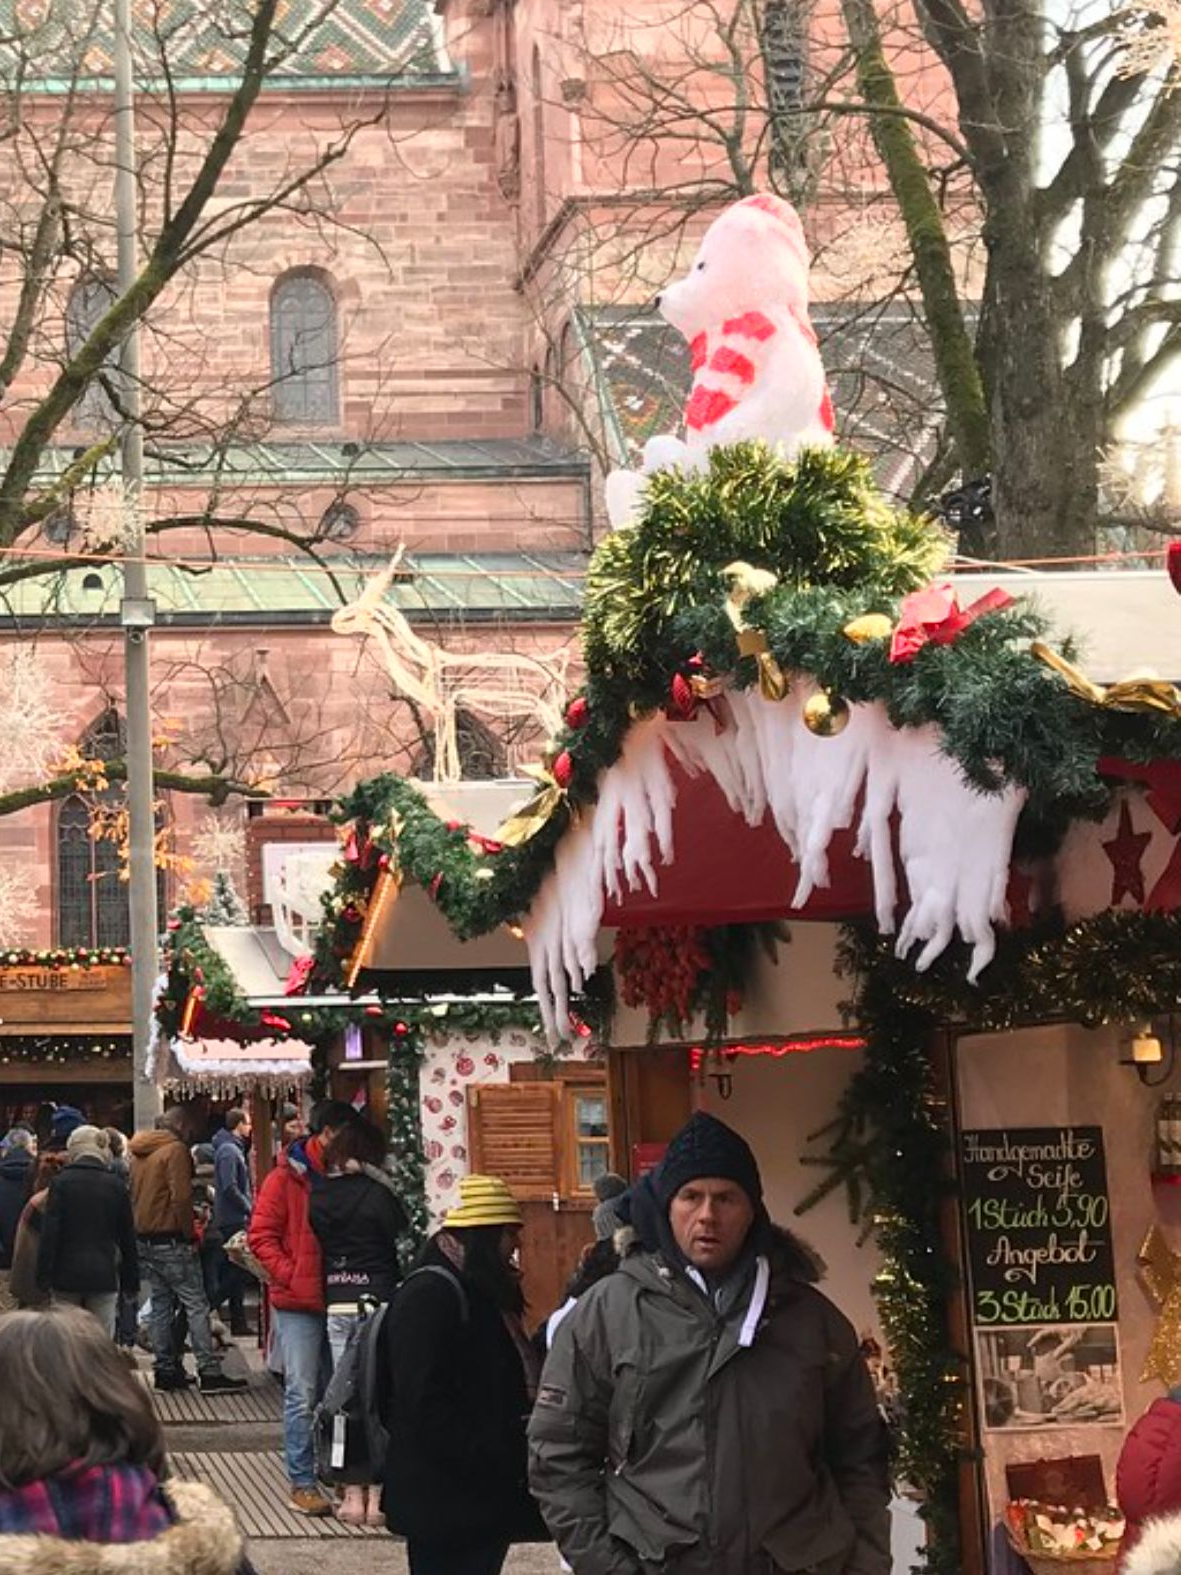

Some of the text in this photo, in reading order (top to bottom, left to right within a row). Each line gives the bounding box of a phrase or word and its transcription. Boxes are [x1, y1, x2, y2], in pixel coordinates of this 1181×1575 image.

[963, 1129, 1096, 1181] Handgemachte
[1026, 1163, 1084, 1199] Seife
[986, 1229, 1106, 1285] Angebot
